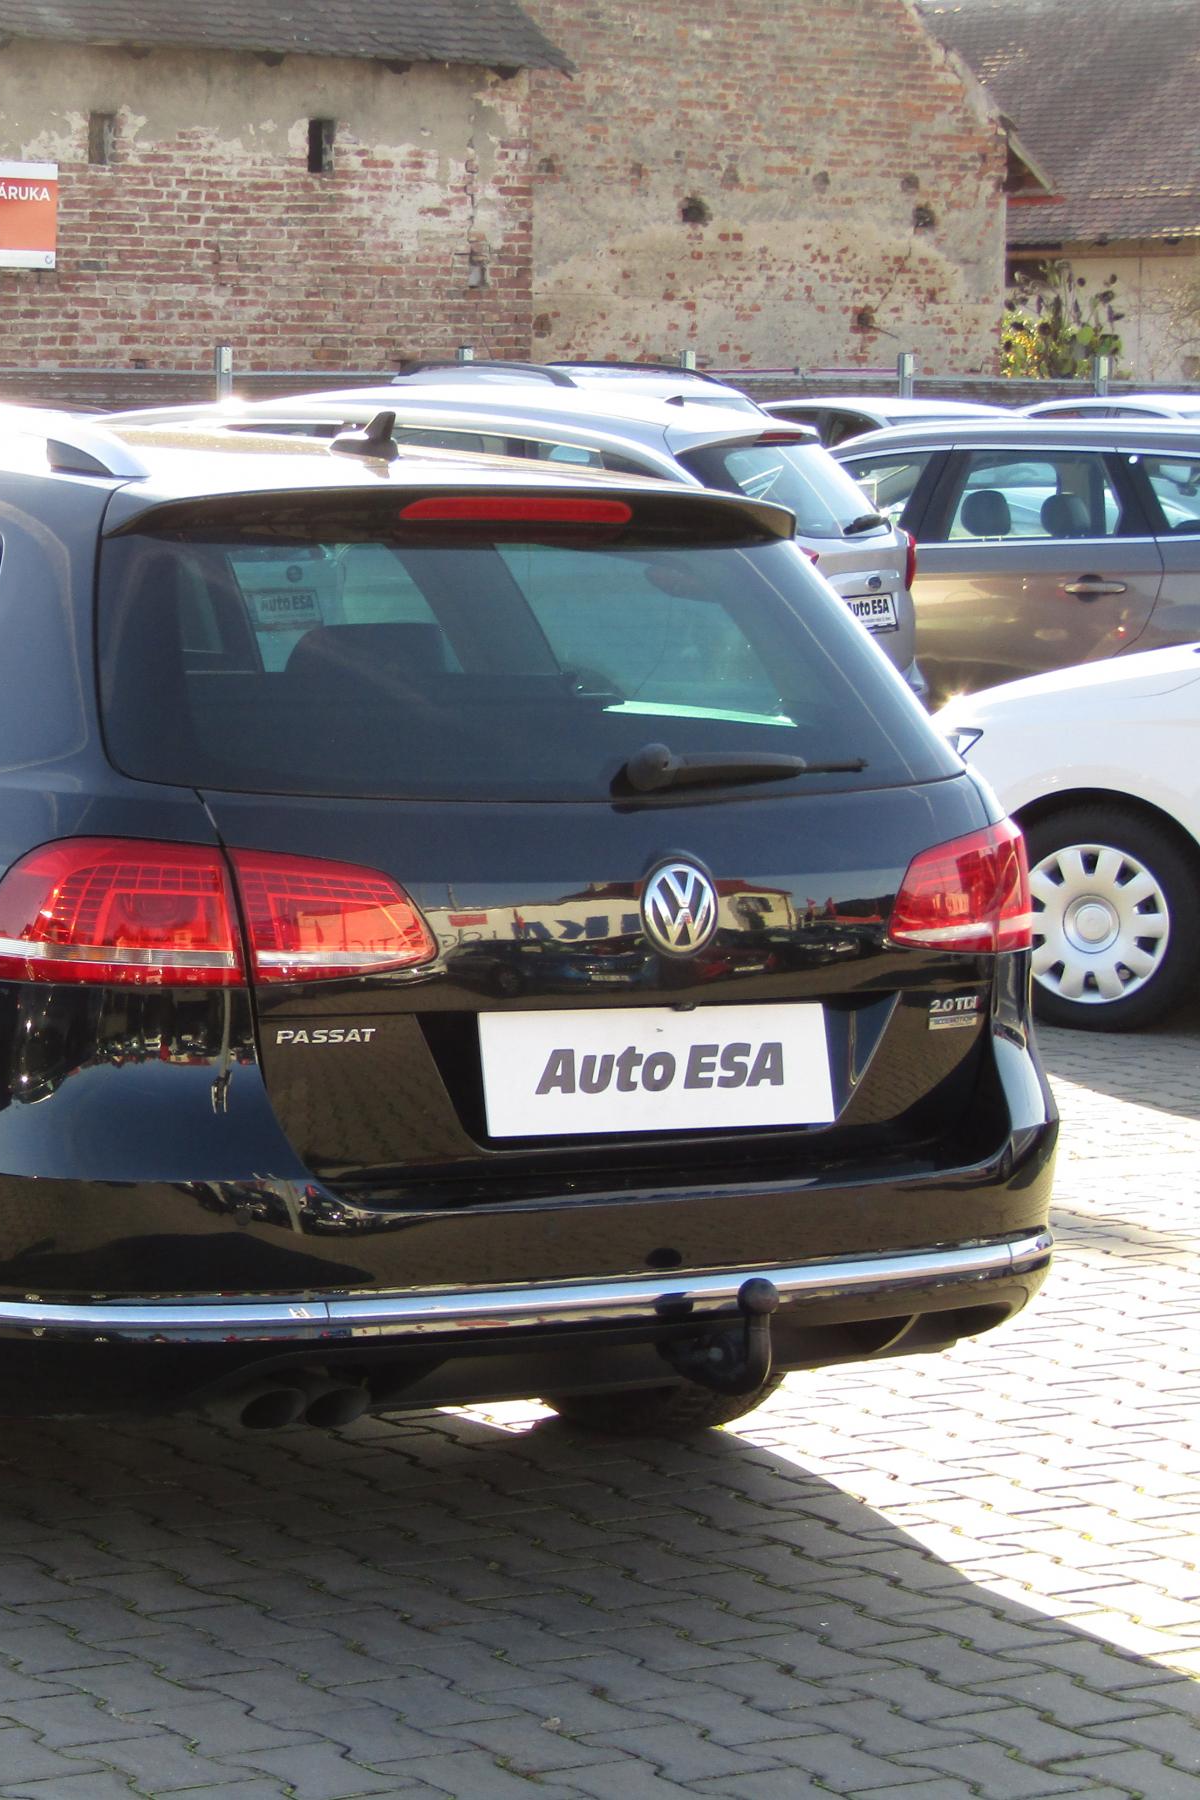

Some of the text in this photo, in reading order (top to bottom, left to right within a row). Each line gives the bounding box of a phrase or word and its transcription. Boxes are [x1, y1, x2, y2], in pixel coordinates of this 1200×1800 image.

[871, 598, 890, 615] ESA
[955, 995, 980, 1011] TDI
[276, 1028, 376, 1044] PASSAT
[535, 1042, 785, 1095] Auto ESA
